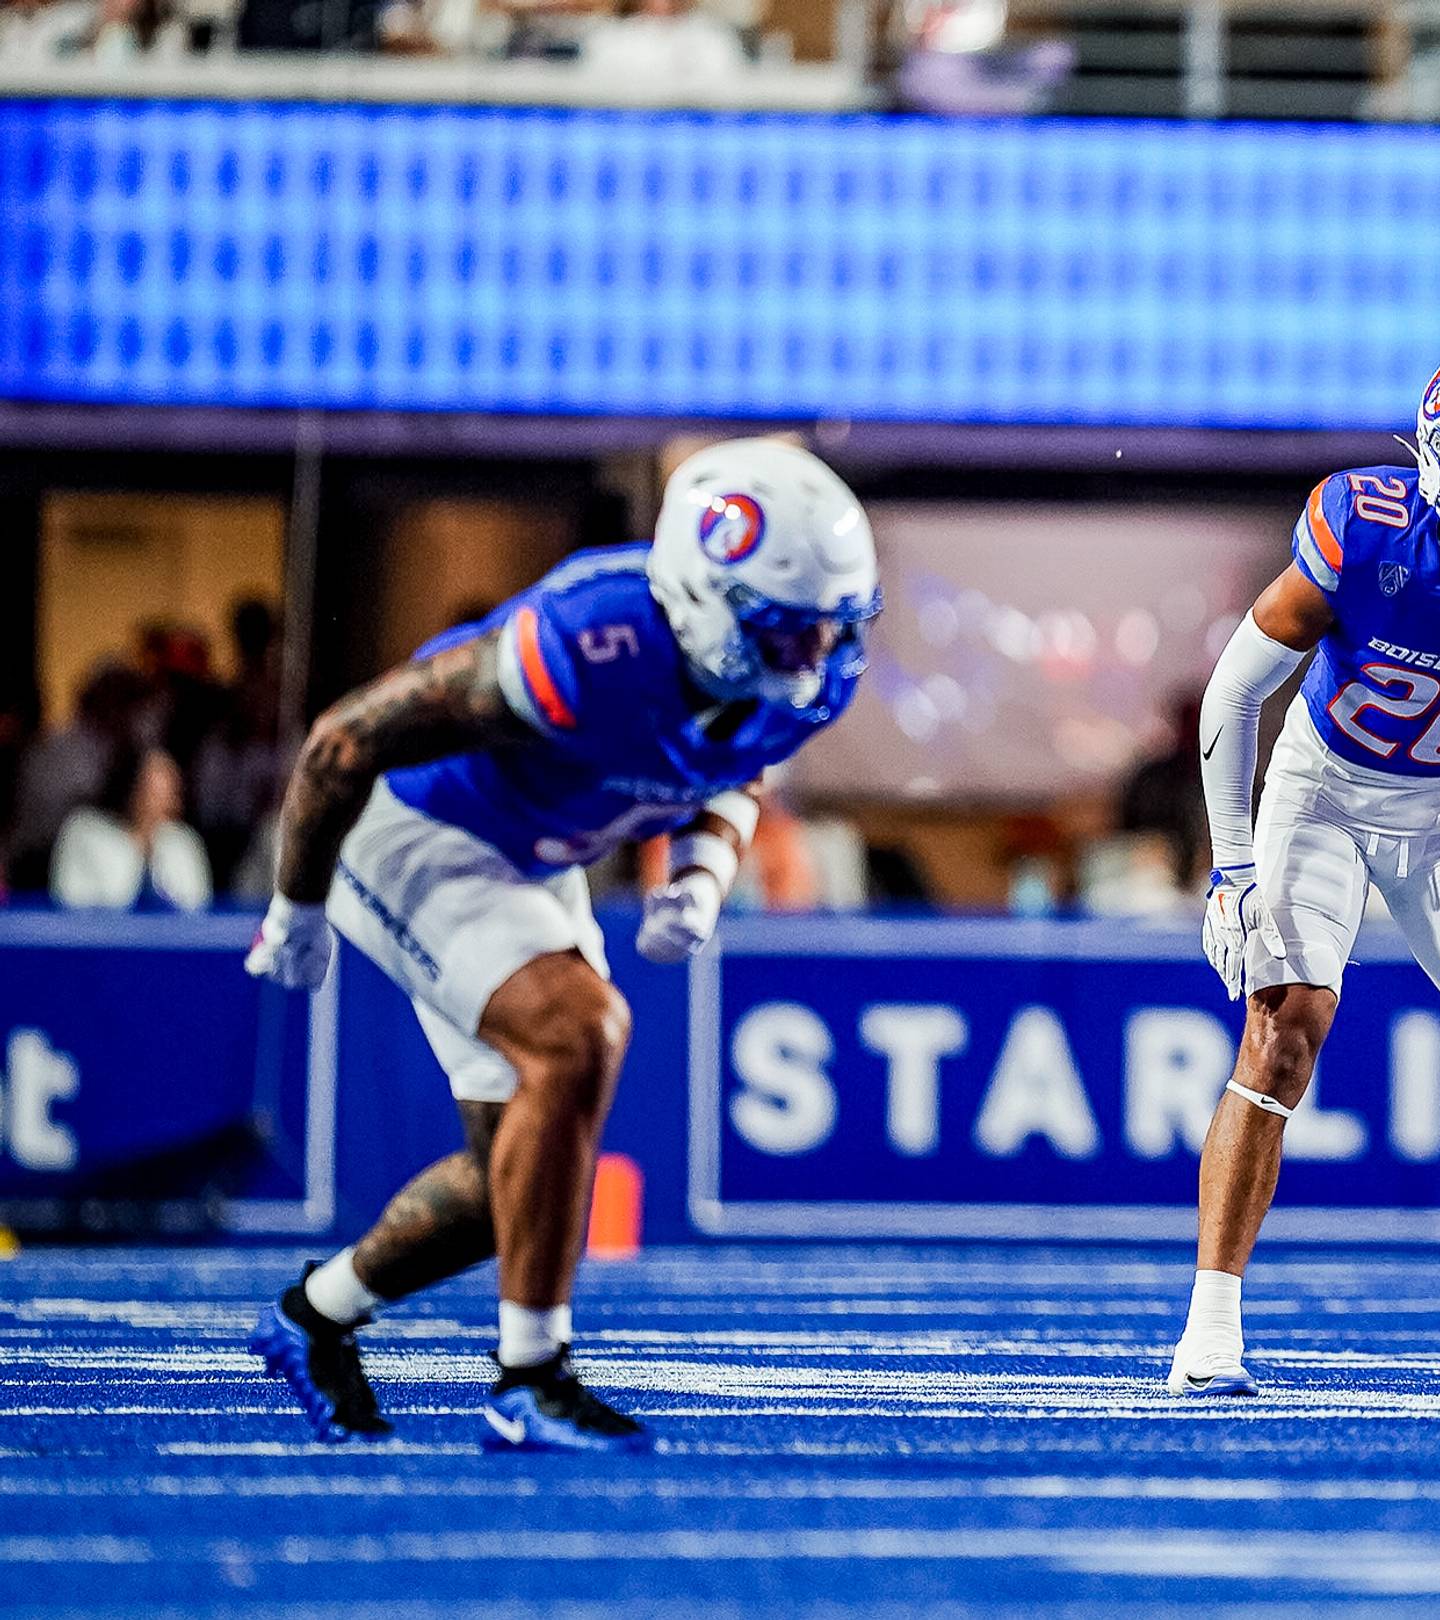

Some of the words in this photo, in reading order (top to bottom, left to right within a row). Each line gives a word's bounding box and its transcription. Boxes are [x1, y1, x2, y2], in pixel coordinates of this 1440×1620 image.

[1347, 473, 1409, 529] 20
[577, 624, 640, 664] 5
[0, 1027, 80, 1169] t
